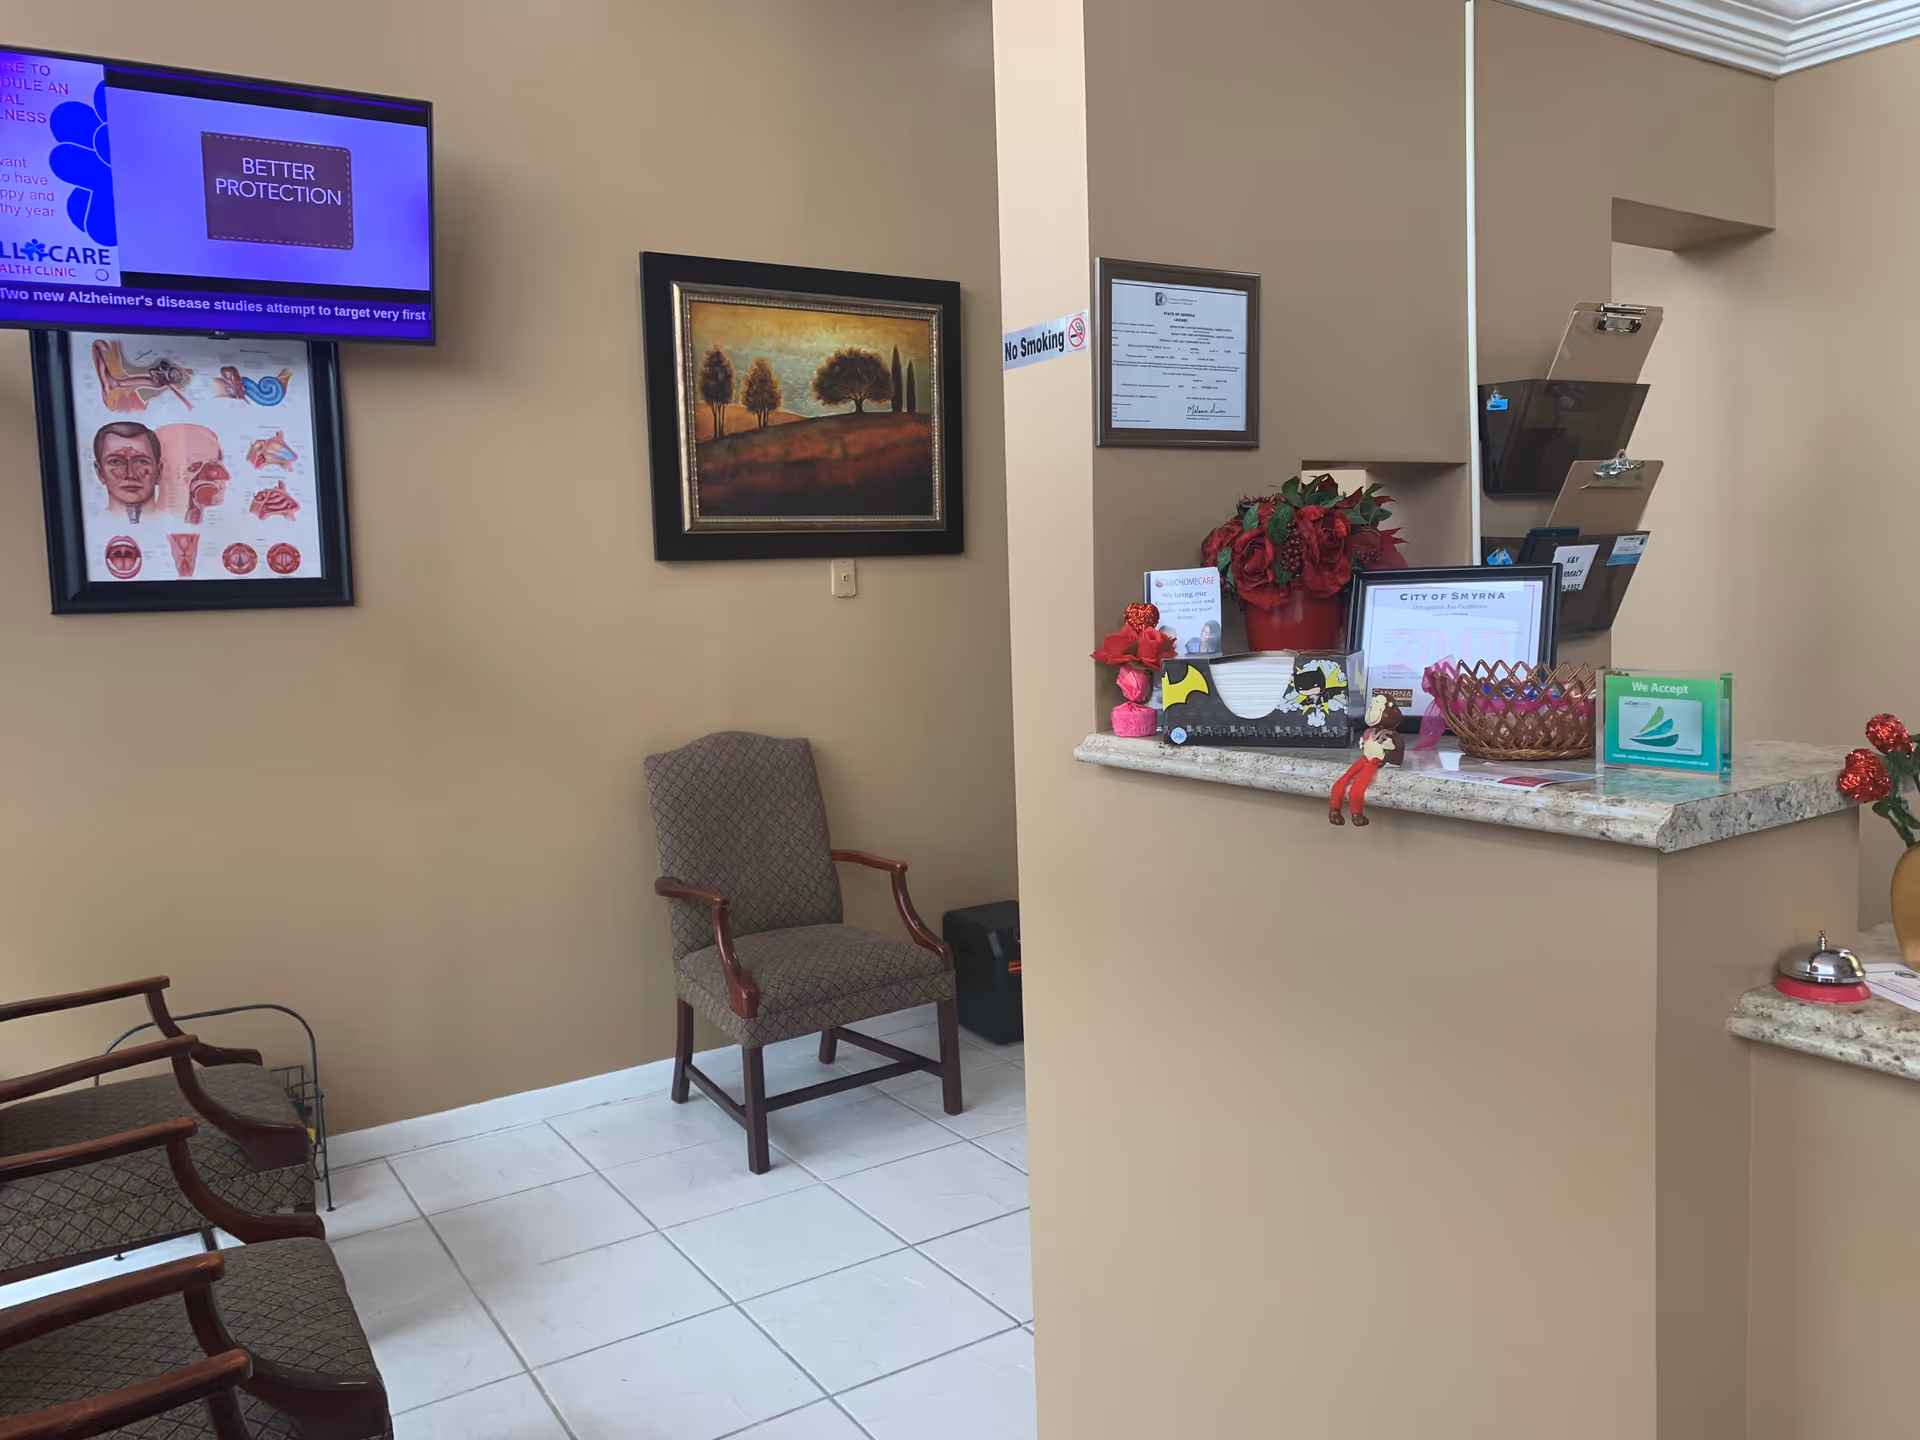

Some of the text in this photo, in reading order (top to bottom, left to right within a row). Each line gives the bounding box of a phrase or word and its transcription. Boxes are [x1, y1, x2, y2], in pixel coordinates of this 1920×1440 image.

[29, 63, 51, 76] TO
[49, 81, 68, 94] AN
[0, 93, 25, 105] AL
[242, 157, 315, 180] BETTER
[15, 172, 48, 185] have
[29, 191, 56, 202] and
[215, 178, 342, 206] PROTECTION
[25, 206, 56, 217] year
[48, 245, 111, 265] CARE
[34, 265, 77, 278] CLINIC
[0, 287, 29, 300] Two
[33, 291, 65, 302] new
[68, 291, 153, 306] Alzheimer's
[156, 296, 210, 310] disease
[214, 300, 263, 313] studies
[266, 303, 315, 318] attempt
[318, 305, 331, 316] to
[334, 306, 371, 320] target
[373, 310, 400, 322] very
[402, 309, 426, 321] first
[1005, 329, 1065, 361] No Smoking
[1400, 592, 1506, 601] CITY OF SMYRNA
[1632, 681, 1689, 696] We Accept
